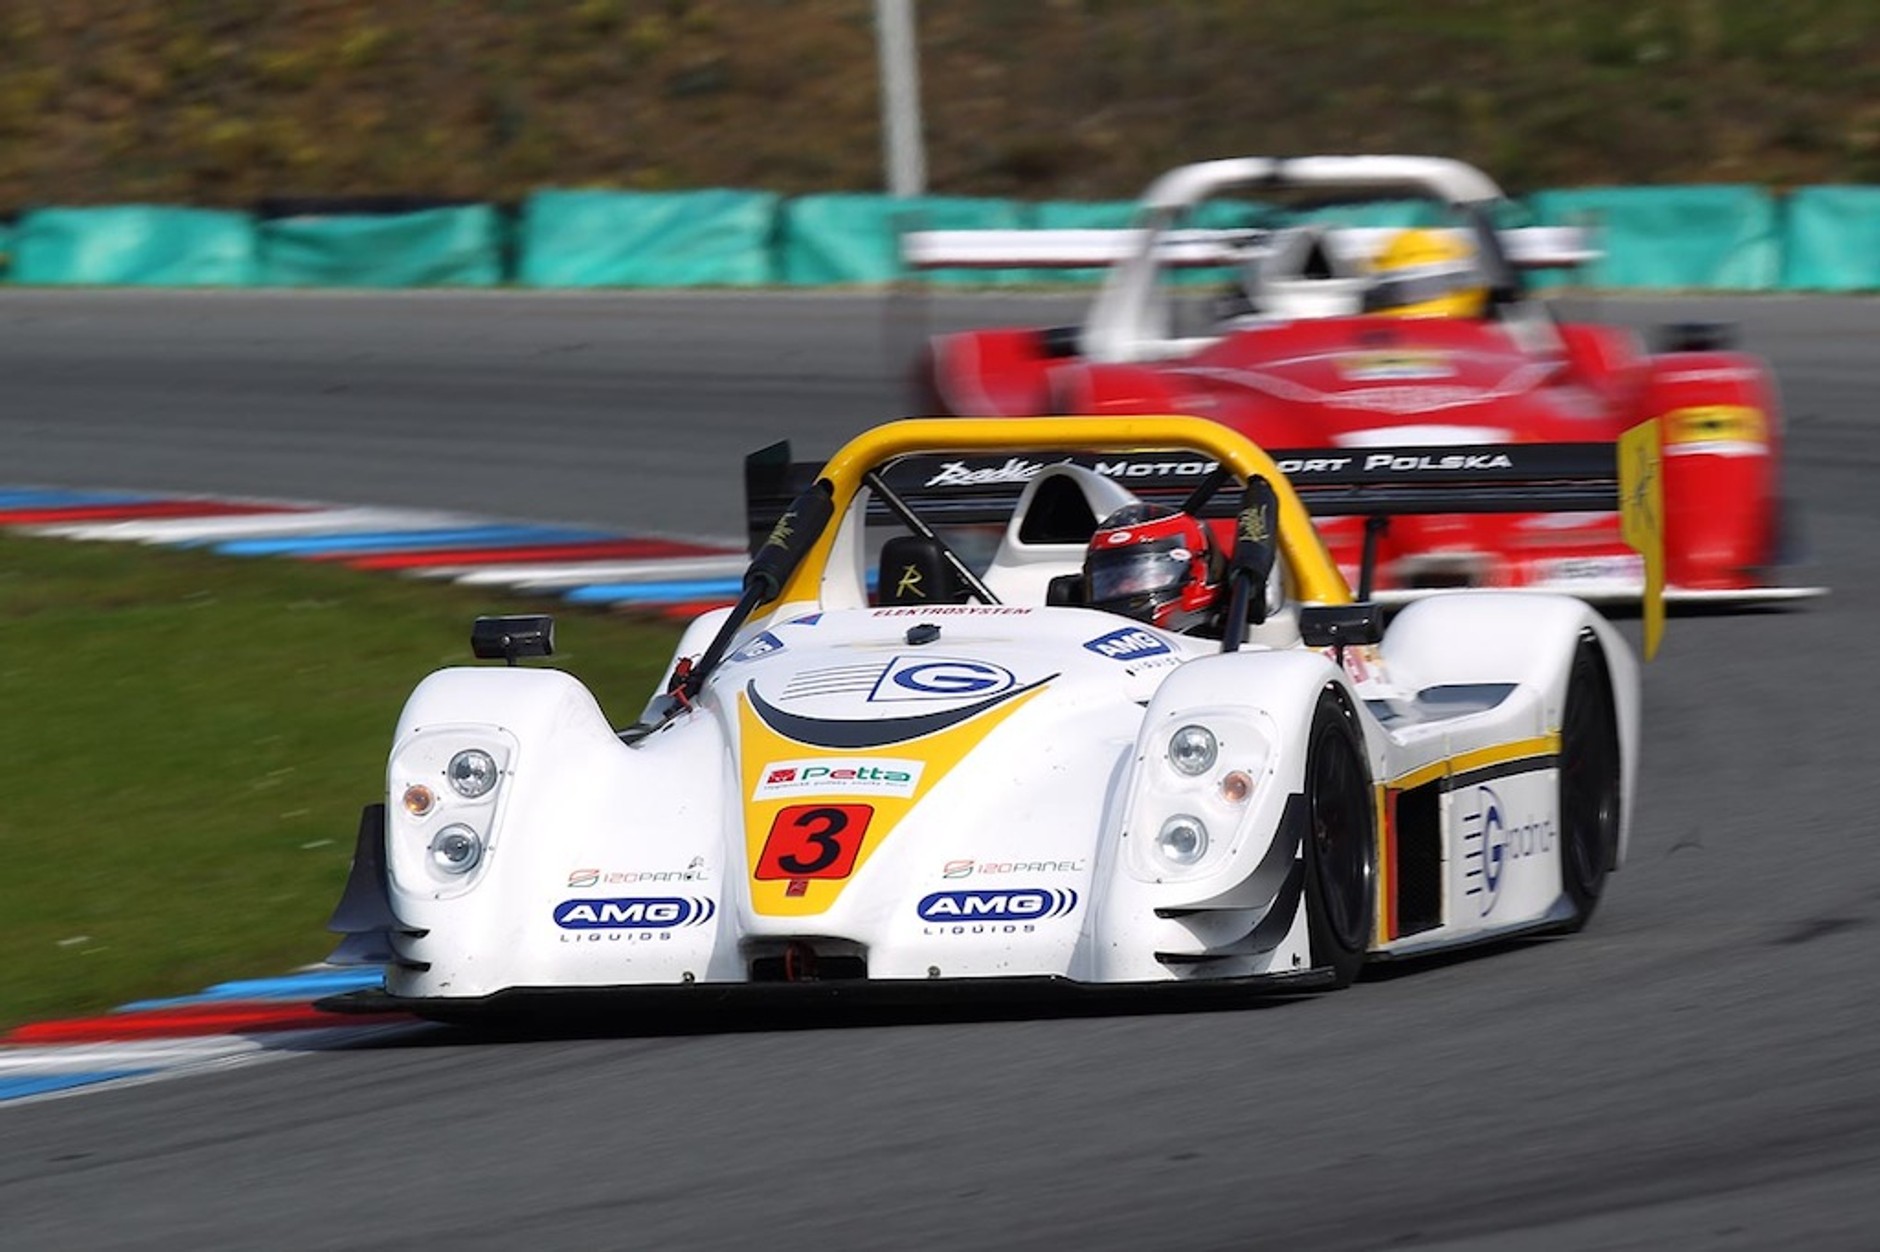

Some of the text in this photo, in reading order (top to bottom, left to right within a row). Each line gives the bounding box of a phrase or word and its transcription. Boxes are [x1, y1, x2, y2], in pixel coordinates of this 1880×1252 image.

[872, 607, 1033, 617] ELEKTROSYSTEM
[1096, 631, 1161, 657] AMG
[802, 767, 911, 782] Petta
[778, 808, 848, 874] 3
[560, 903, 680, 922] AMG
[924, 895, 1044, 915] AMG
[560, 932, 671, 942] LIQUIDS
[923, 924, 1035, 935] LIQUIDS
